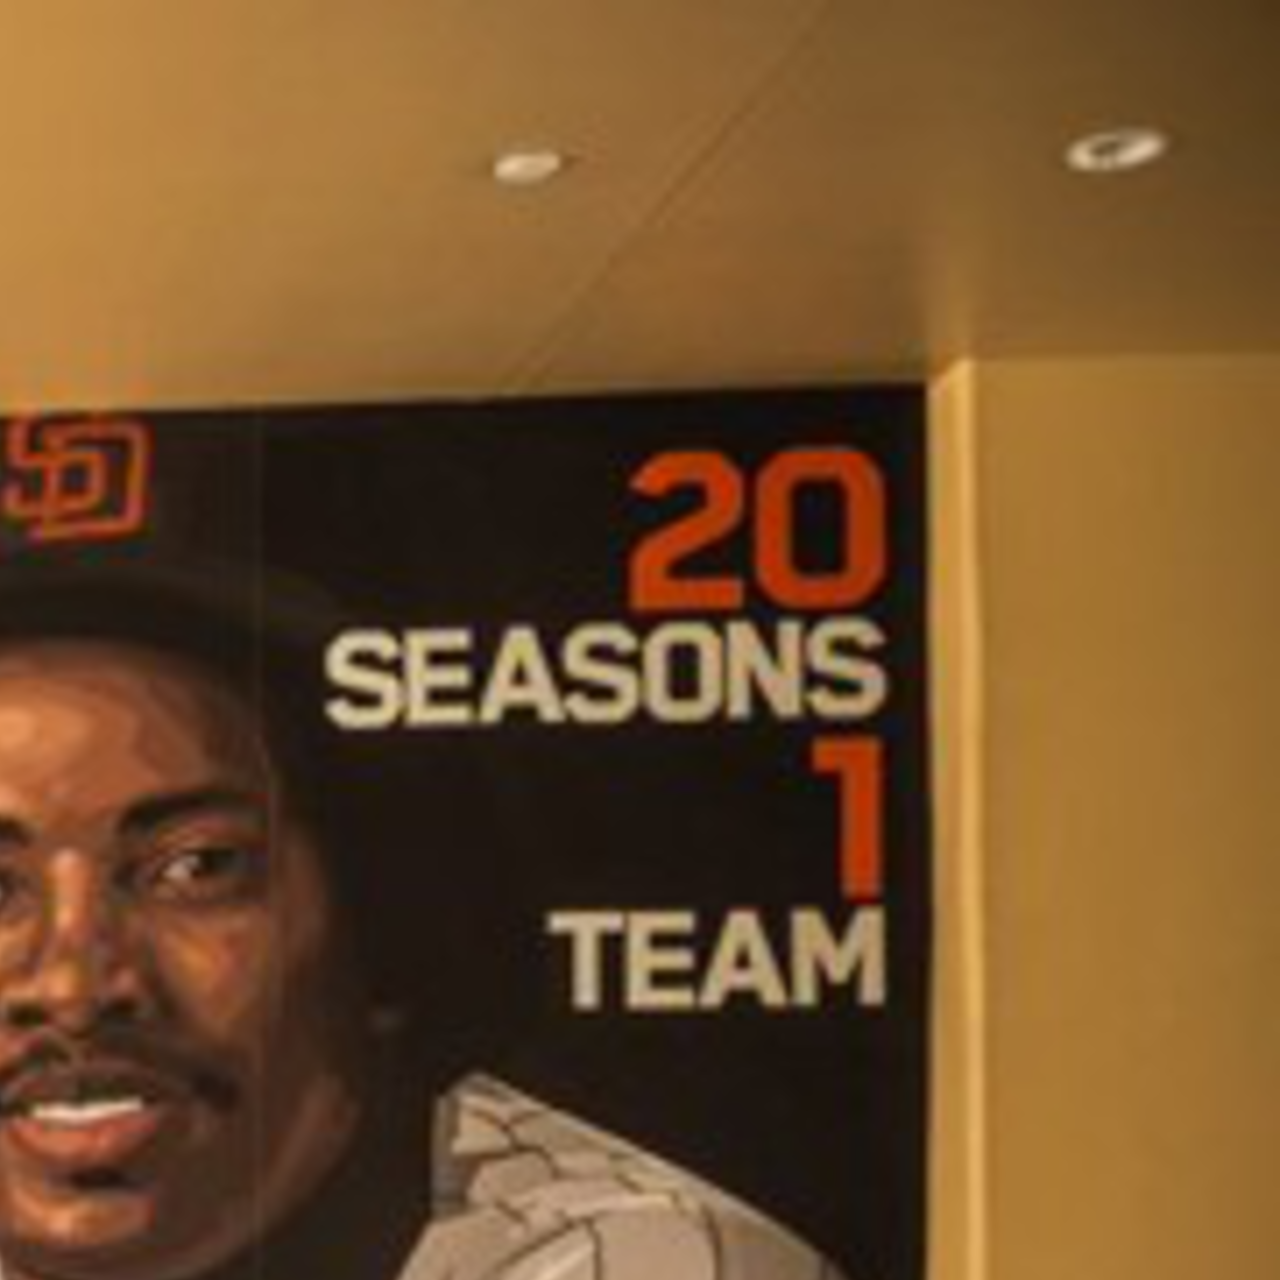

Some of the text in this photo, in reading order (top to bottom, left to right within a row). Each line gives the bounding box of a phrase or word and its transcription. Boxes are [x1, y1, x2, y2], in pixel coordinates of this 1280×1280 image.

[628, 446, 888, 614] 20
[324, 620, 888, 729] SEASONS
[809, 736, 883, 898] 1
[547, 908, 886, 1011] TEAM
